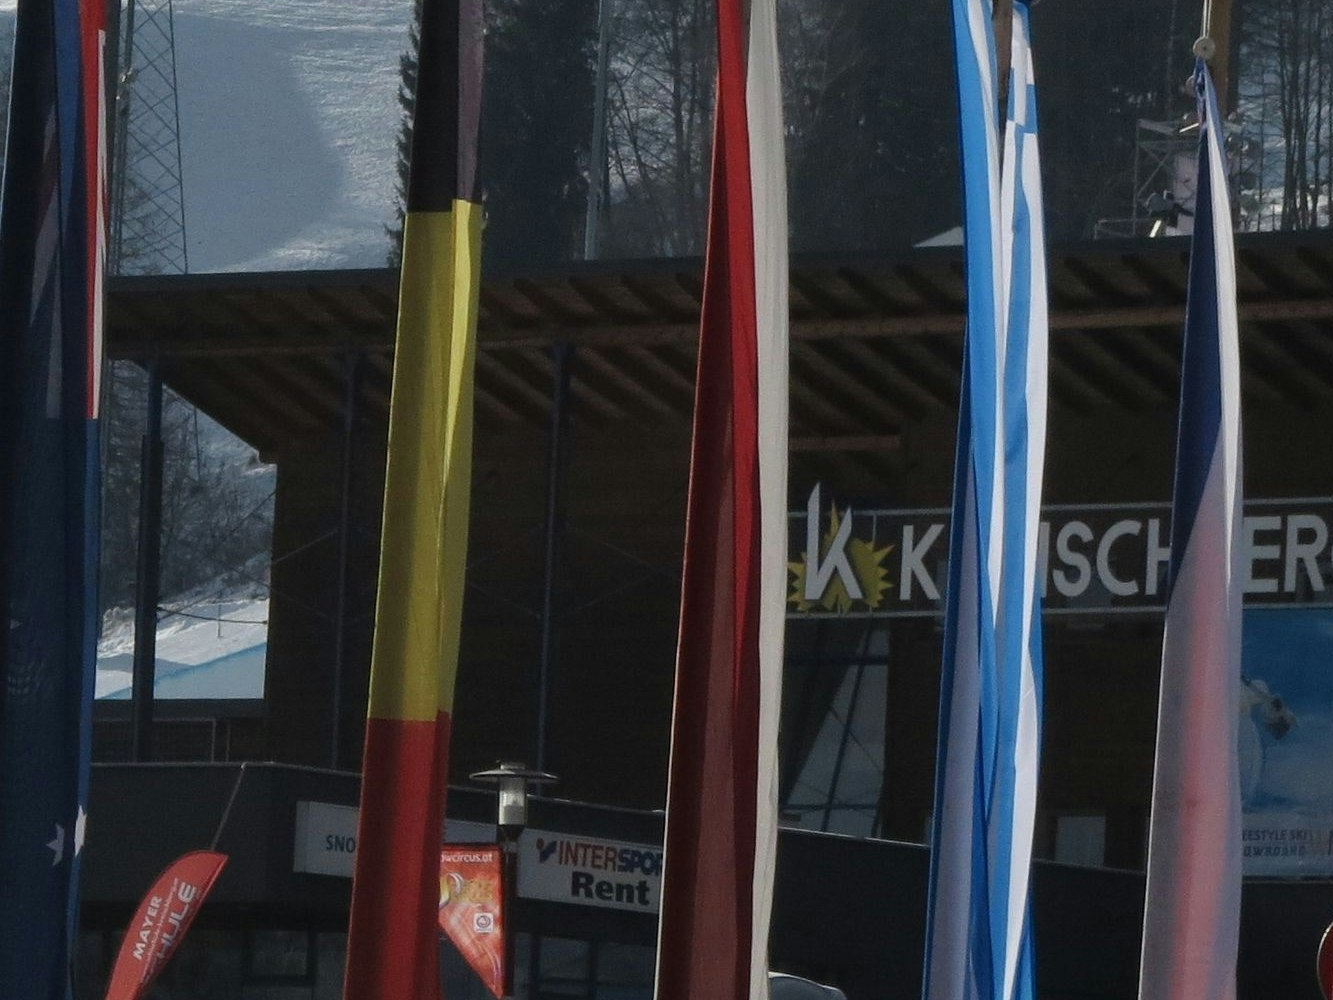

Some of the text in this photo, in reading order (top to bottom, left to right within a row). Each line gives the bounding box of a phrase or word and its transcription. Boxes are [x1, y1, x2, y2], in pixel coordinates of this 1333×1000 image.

[559, 839, 662, 877] INTERSPOR
[571, 870, 651, 906] Rent
[132, 895, 163, 961] MAYER
